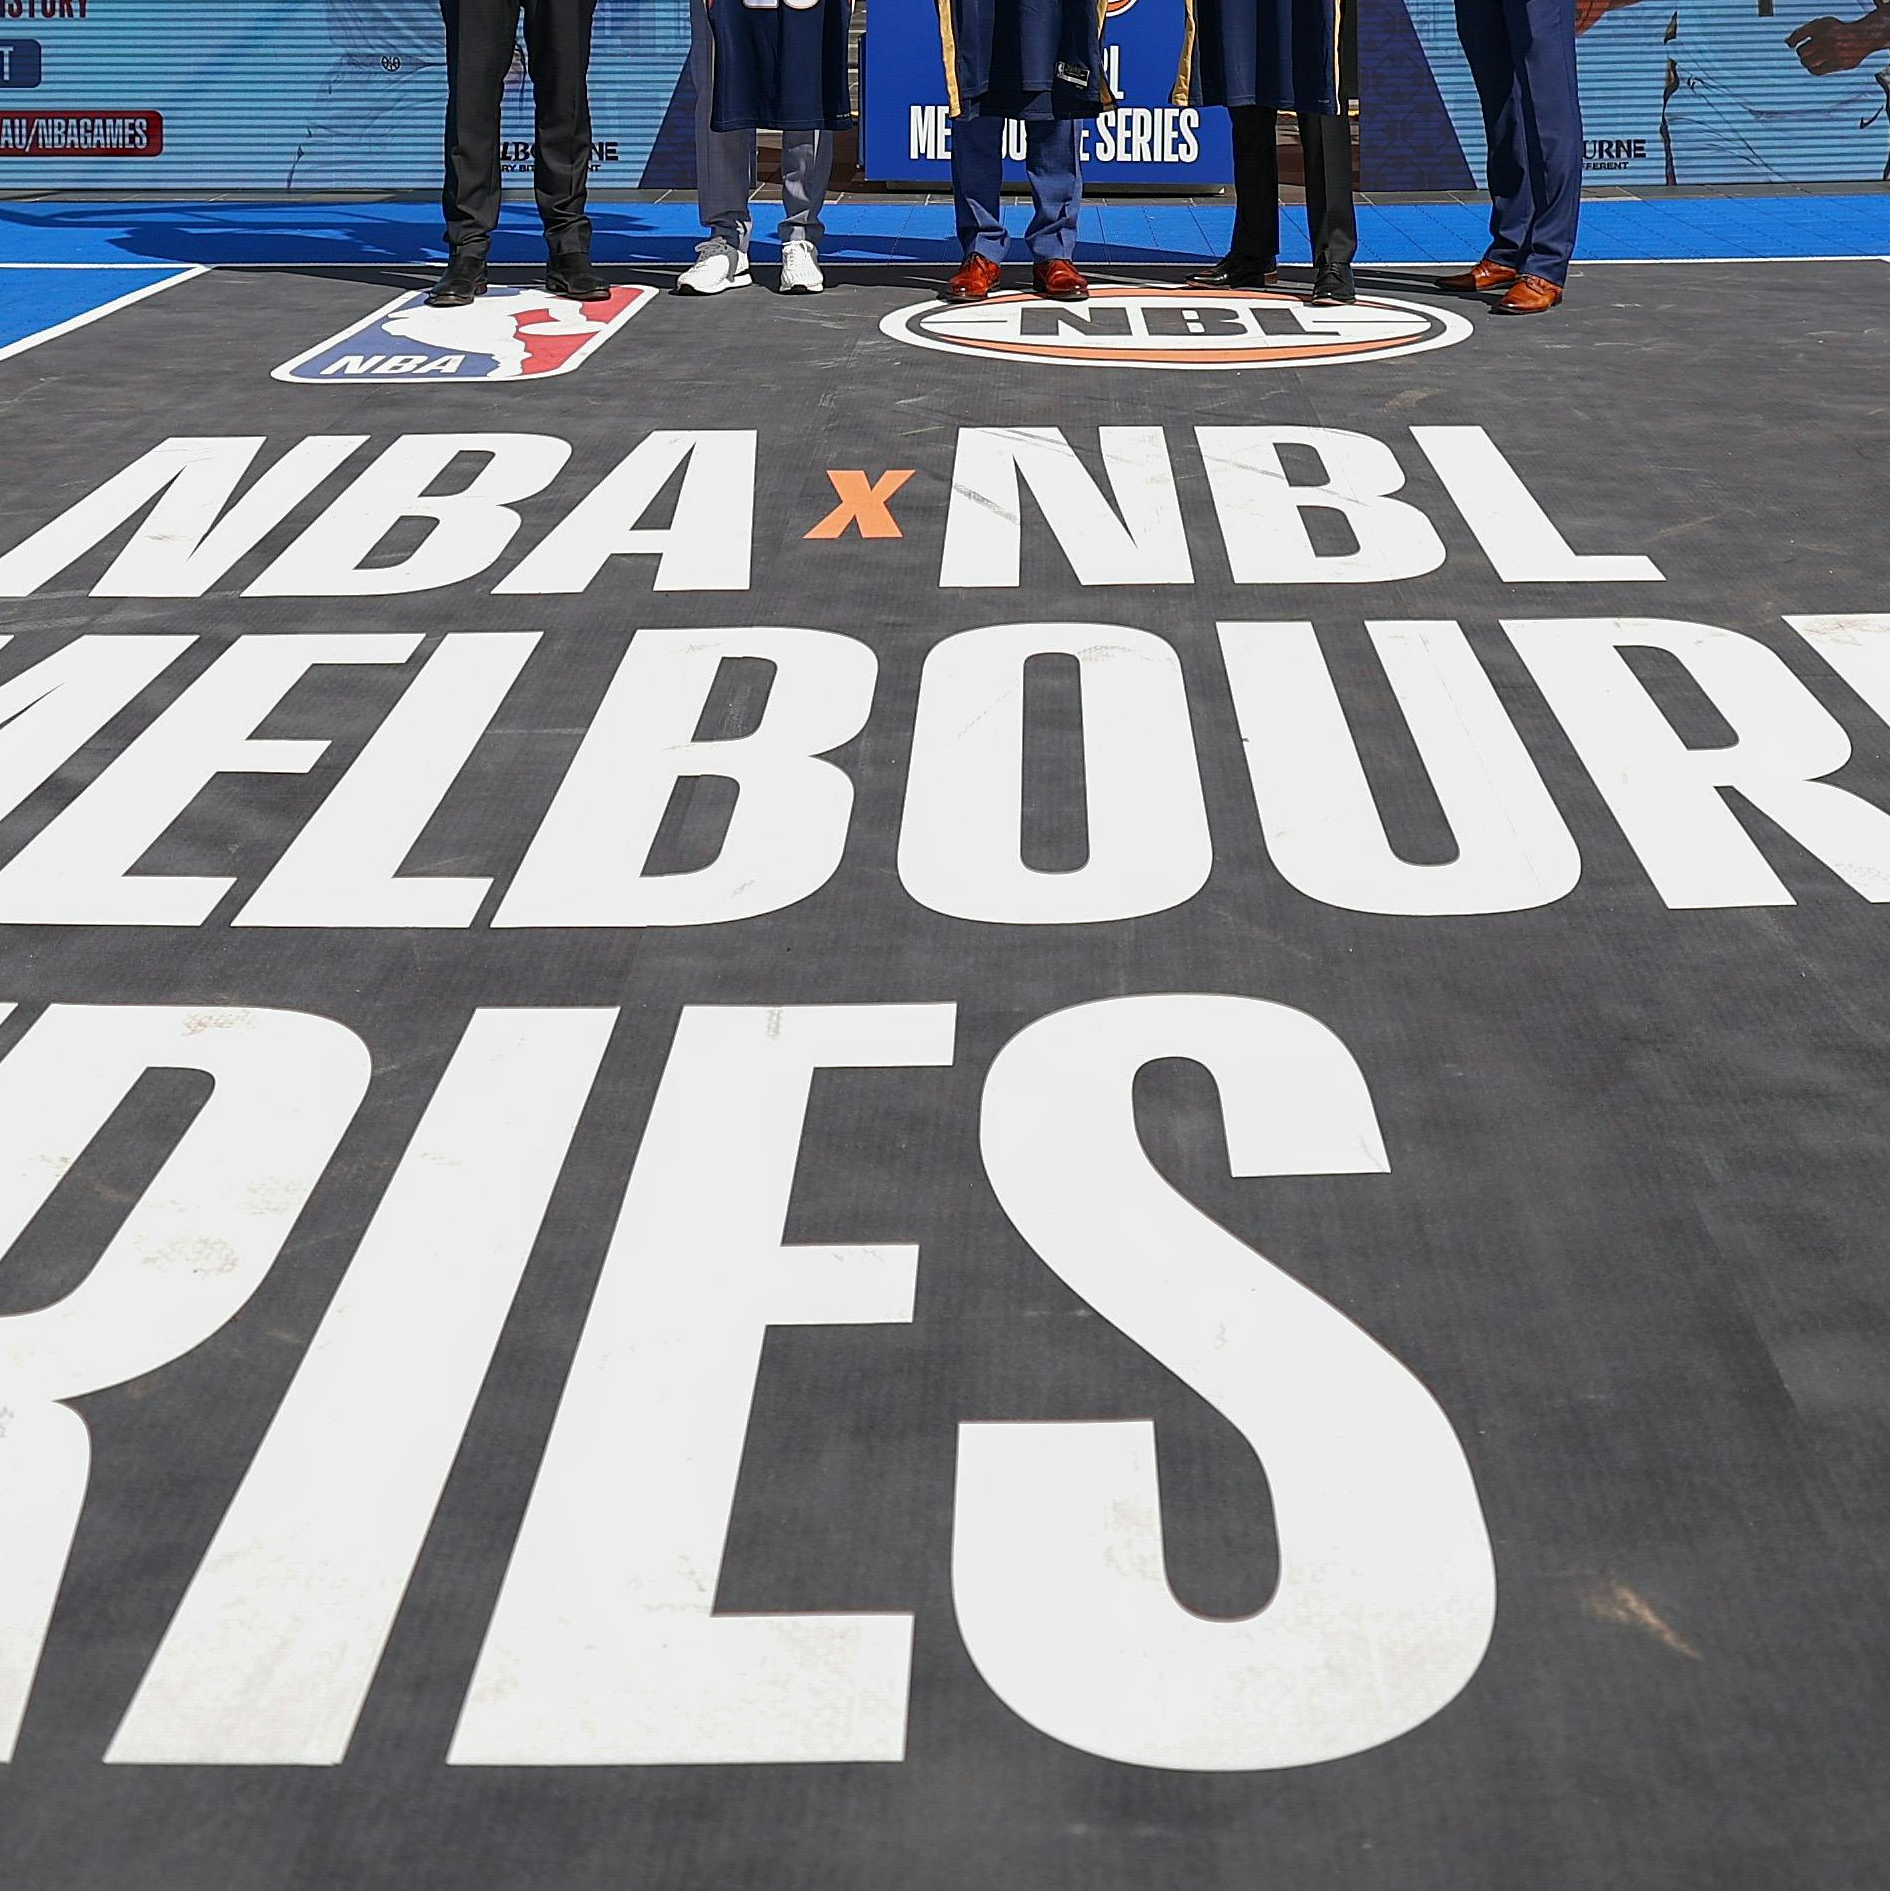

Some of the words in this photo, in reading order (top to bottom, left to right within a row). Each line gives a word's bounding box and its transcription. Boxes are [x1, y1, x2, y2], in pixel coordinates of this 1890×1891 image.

[1095, 108, 1200, 163] SERIES
[1019, 305, 1341, 337] NBL
[319, 353, 466, 375] NBA
[939, 424, 1666, 588] NBL
